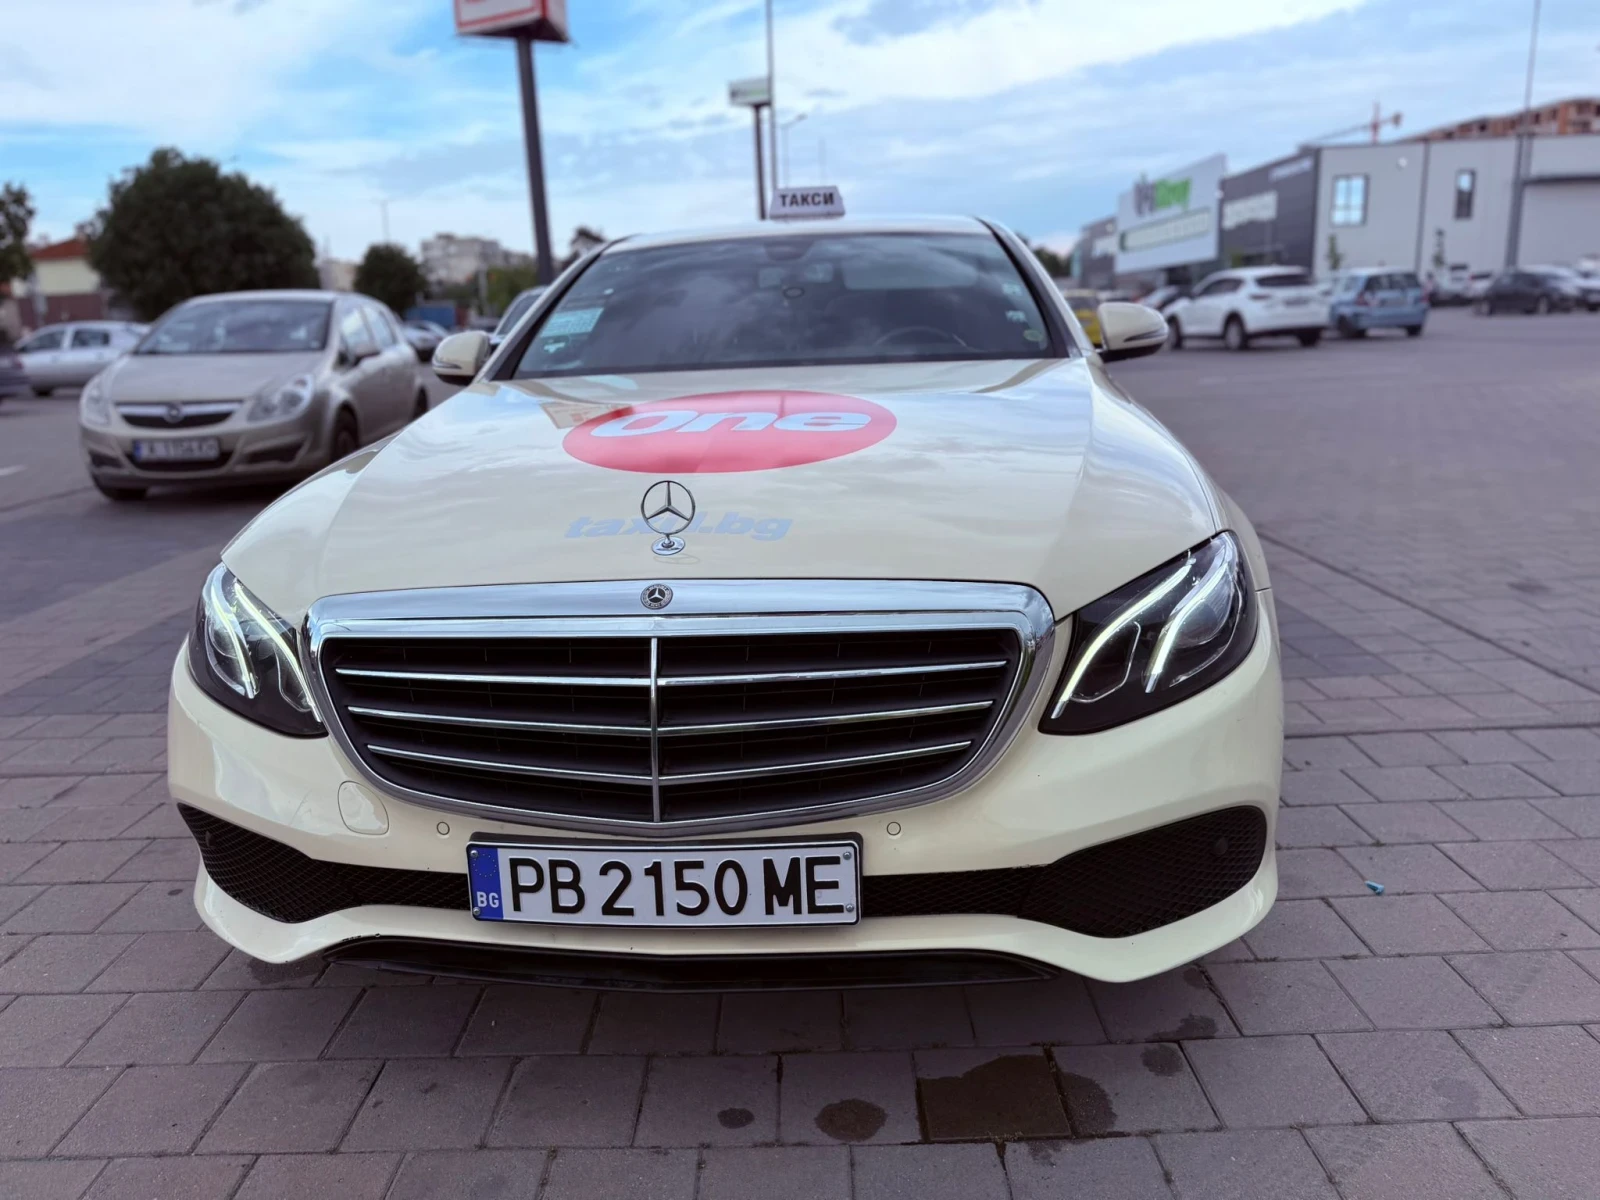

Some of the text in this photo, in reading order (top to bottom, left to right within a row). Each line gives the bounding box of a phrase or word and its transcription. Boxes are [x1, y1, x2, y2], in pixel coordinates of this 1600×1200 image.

[779, 192, 835, 207] ТАКСИ
[590, 410, 872, 437] one
[509, 855, 844, 917] PB 2150 ME
[476, 891, 499, 908] BG
